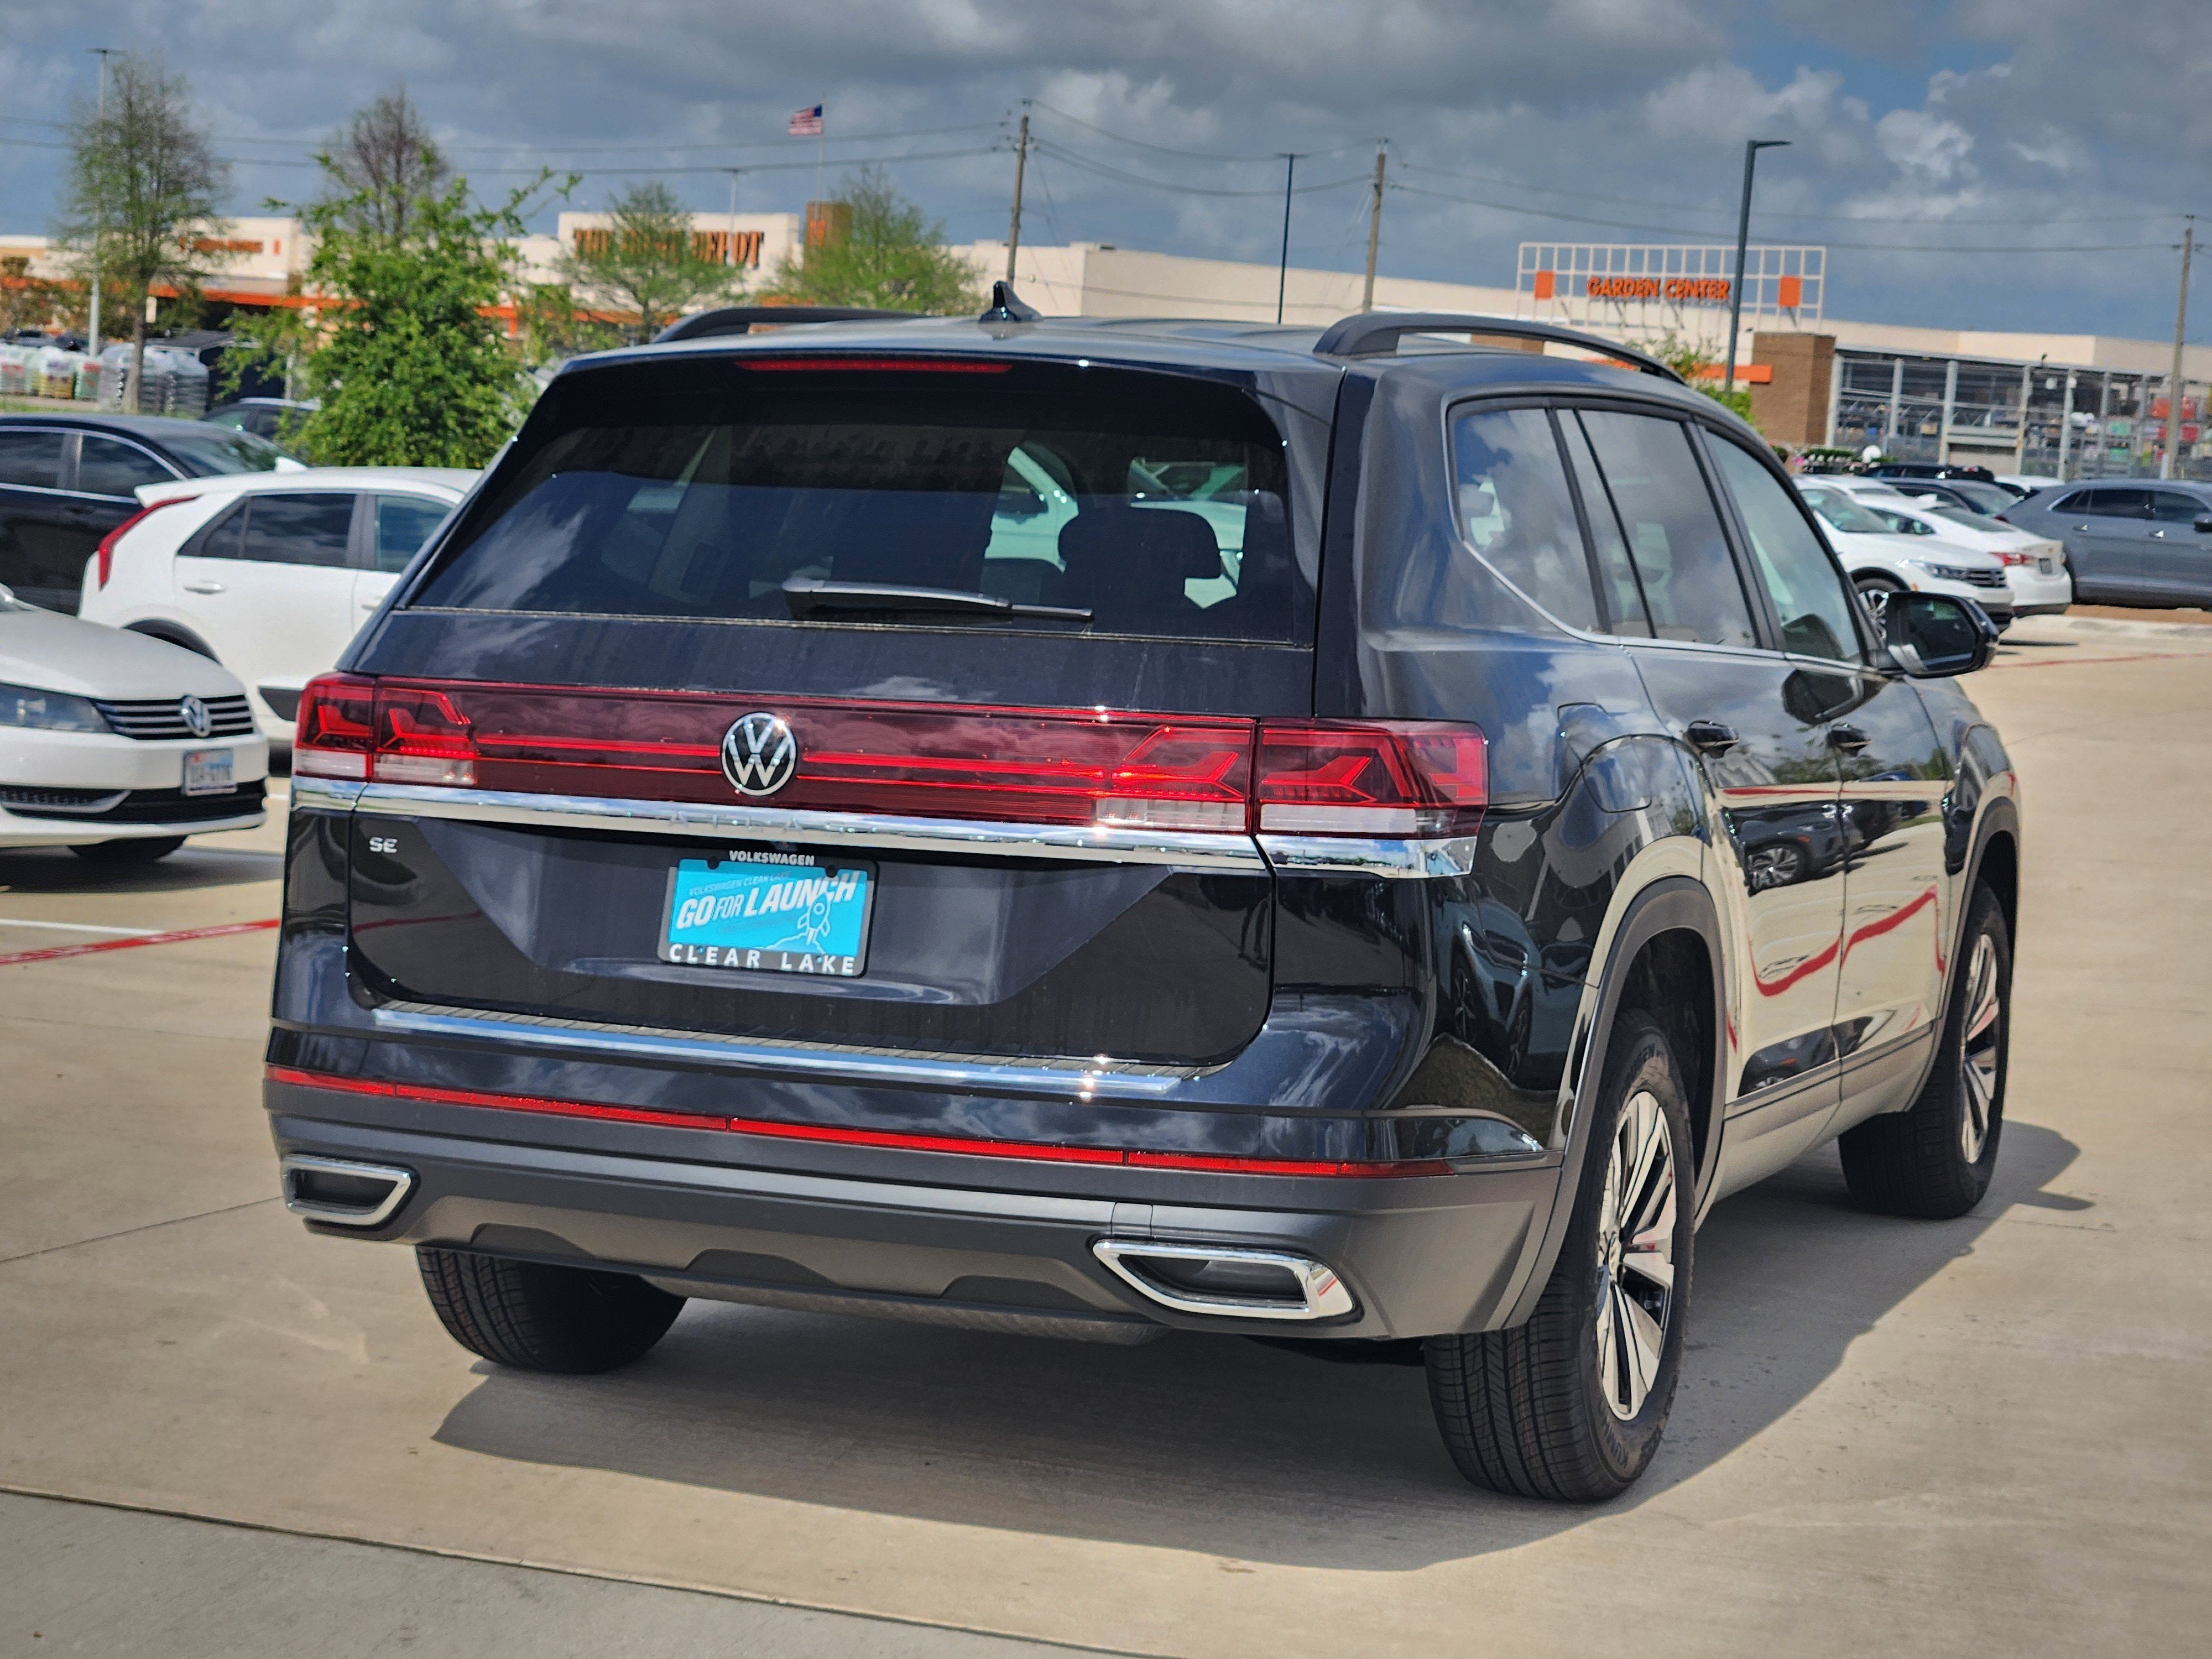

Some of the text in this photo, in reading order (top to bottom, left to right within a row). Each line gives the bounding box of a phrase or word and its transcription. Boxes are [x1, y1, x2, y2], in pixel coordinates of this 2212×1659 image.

[1587, 277, 1730, 300] GARDEN CENTER
[369, 836, 398, 853] SE
[729, 850, 815, 866] VOLKSWAGEN
[676, 895, 717, 930] GO
[712, 894, 745, 921] FOR
[743, 870, 860, 918] LAUNCH
[669, 943, 855, 975] CLEAR LAKE
